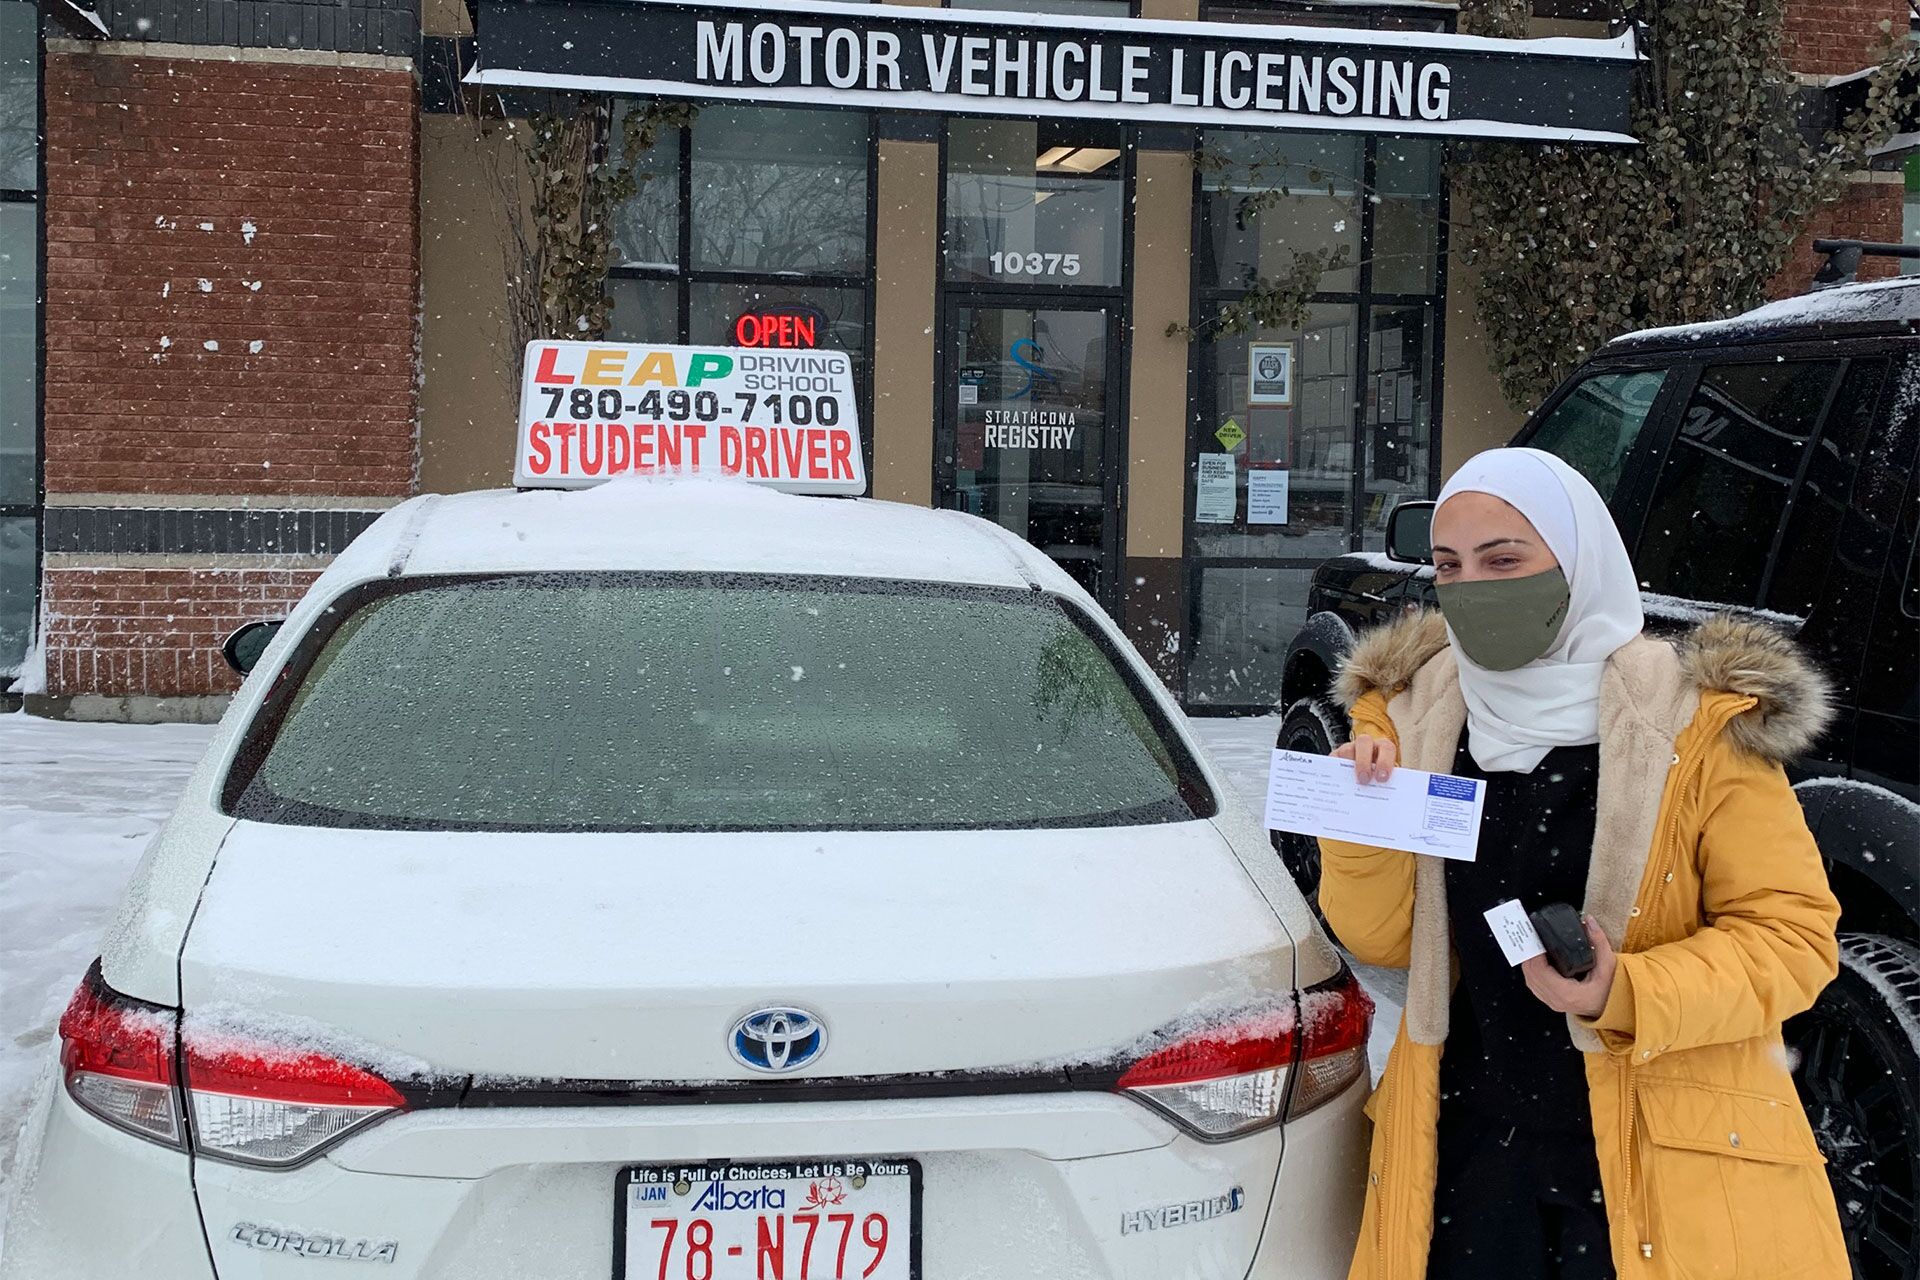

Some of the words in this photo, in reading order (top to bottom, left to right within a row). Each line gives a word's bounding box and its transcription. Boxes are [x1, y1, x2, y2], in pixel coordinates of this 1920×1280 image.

[696, 21, 902, 90] MOTOR
[921, 34, 1150, 103] VEHICLE
[1171, 48, 1450, 120] LICENSING
[989, 252, 1081, 275] 10375
[736, 314, 815, 347] OPEN
[534, 348, 734, 387] LEAP
[740, 356, 845, 374] DRIVING
[745, 374, 842, 393] SCHOOL
[541, 387, 839, 426] 780-490-7100
[985, 410, 1076, 425] STRATHCONA
[528, 421, 706, 475] STUDENT
[719, 426, 855, 479] DRIVER
[985, 425, 1075, 449] REGISTRY
[630, 1170, 658, 1182] Life
[661, 1170, 675, 1182] is
[680, 1168, 706, 1182] Full
[710, 1168, 726, 1181] of
[728, 1166, 792, 1180] Choices,
[795, 1165, 819, 1178] Let
[823, 1165, 843, 1177] Us
[846, 1164, 865, 1176] Be
[868, 1163, 909, 1176] Yours
[641, 1187, 667, 1200] JAN
[691, 1181, 785, 1211] Alberta
[229, 1222, 398, 1263] COROLLA
[651, 1213, 888, 1280] 78-N779
